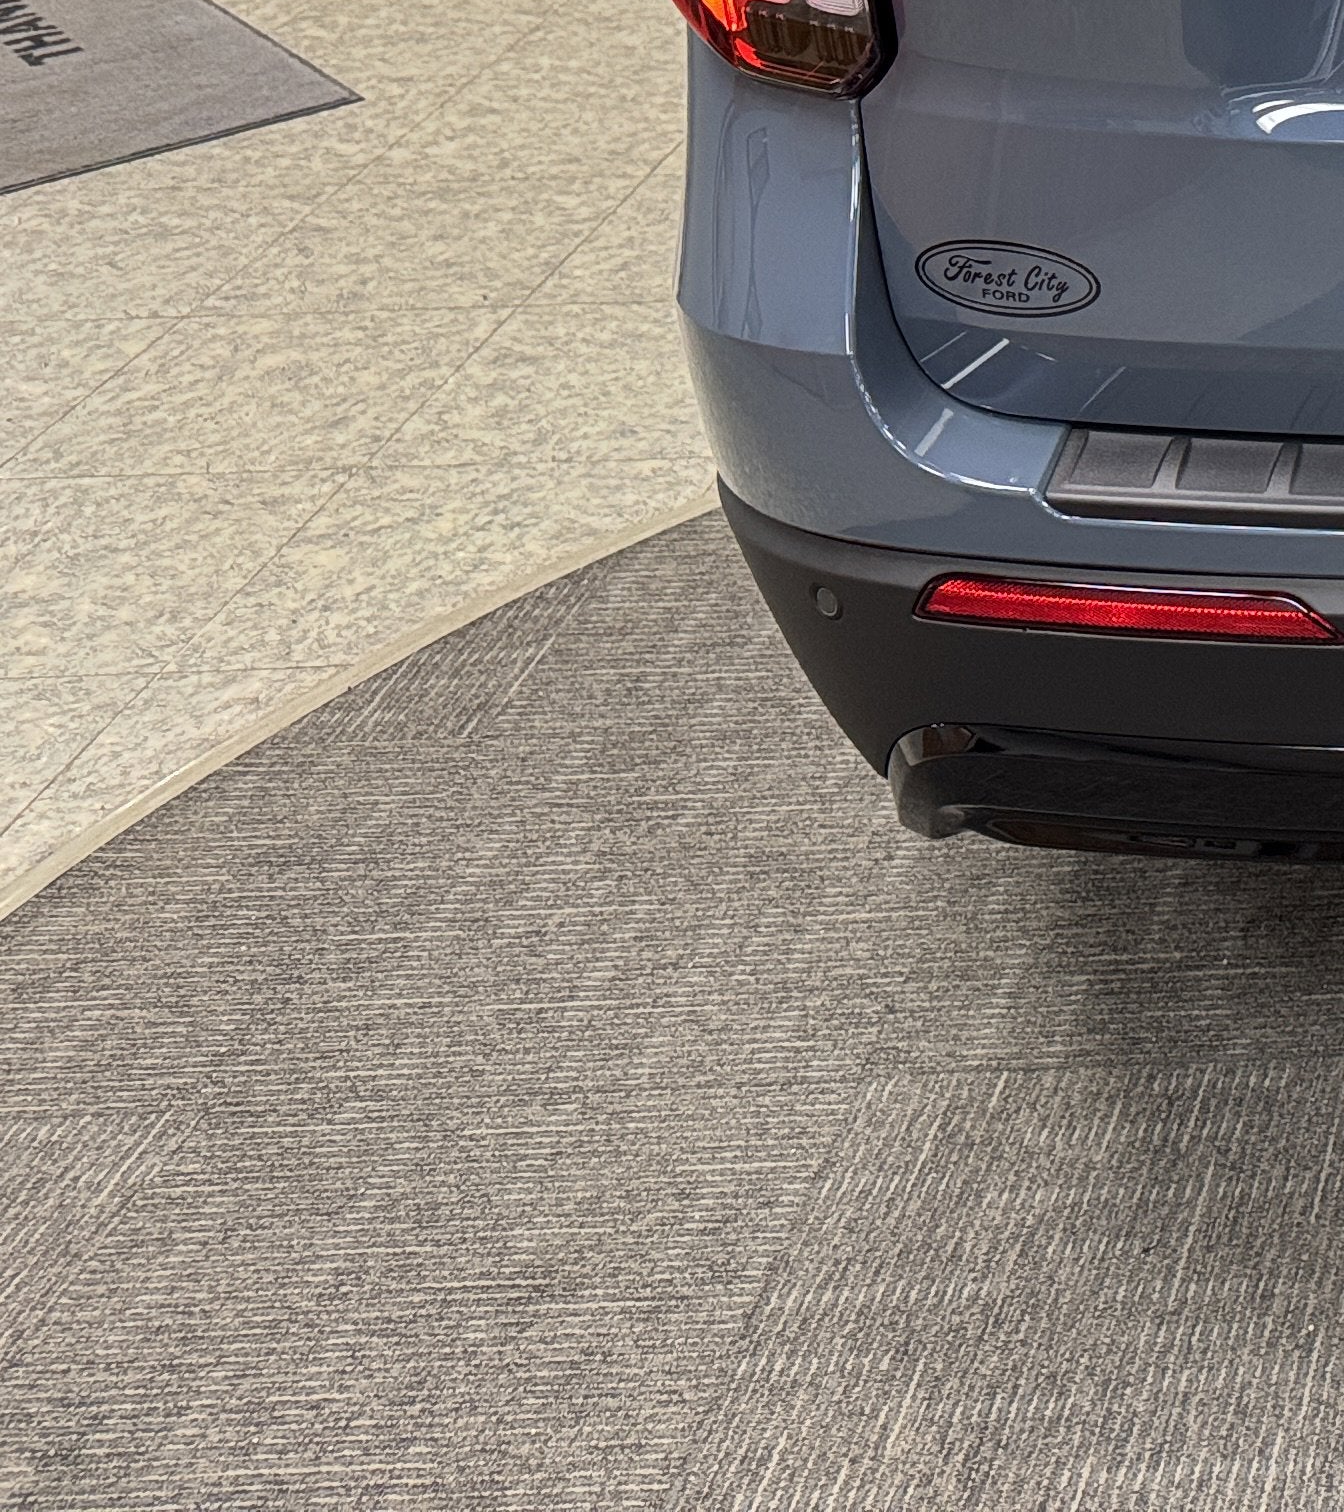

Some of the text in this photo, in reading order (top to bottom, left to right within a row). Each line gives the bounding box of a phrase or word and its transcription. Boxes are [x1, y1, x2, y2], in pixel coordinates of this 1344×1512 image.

[943, 254, 1070, 304] Forest City
[982, 288, 1031, 303] FORD
